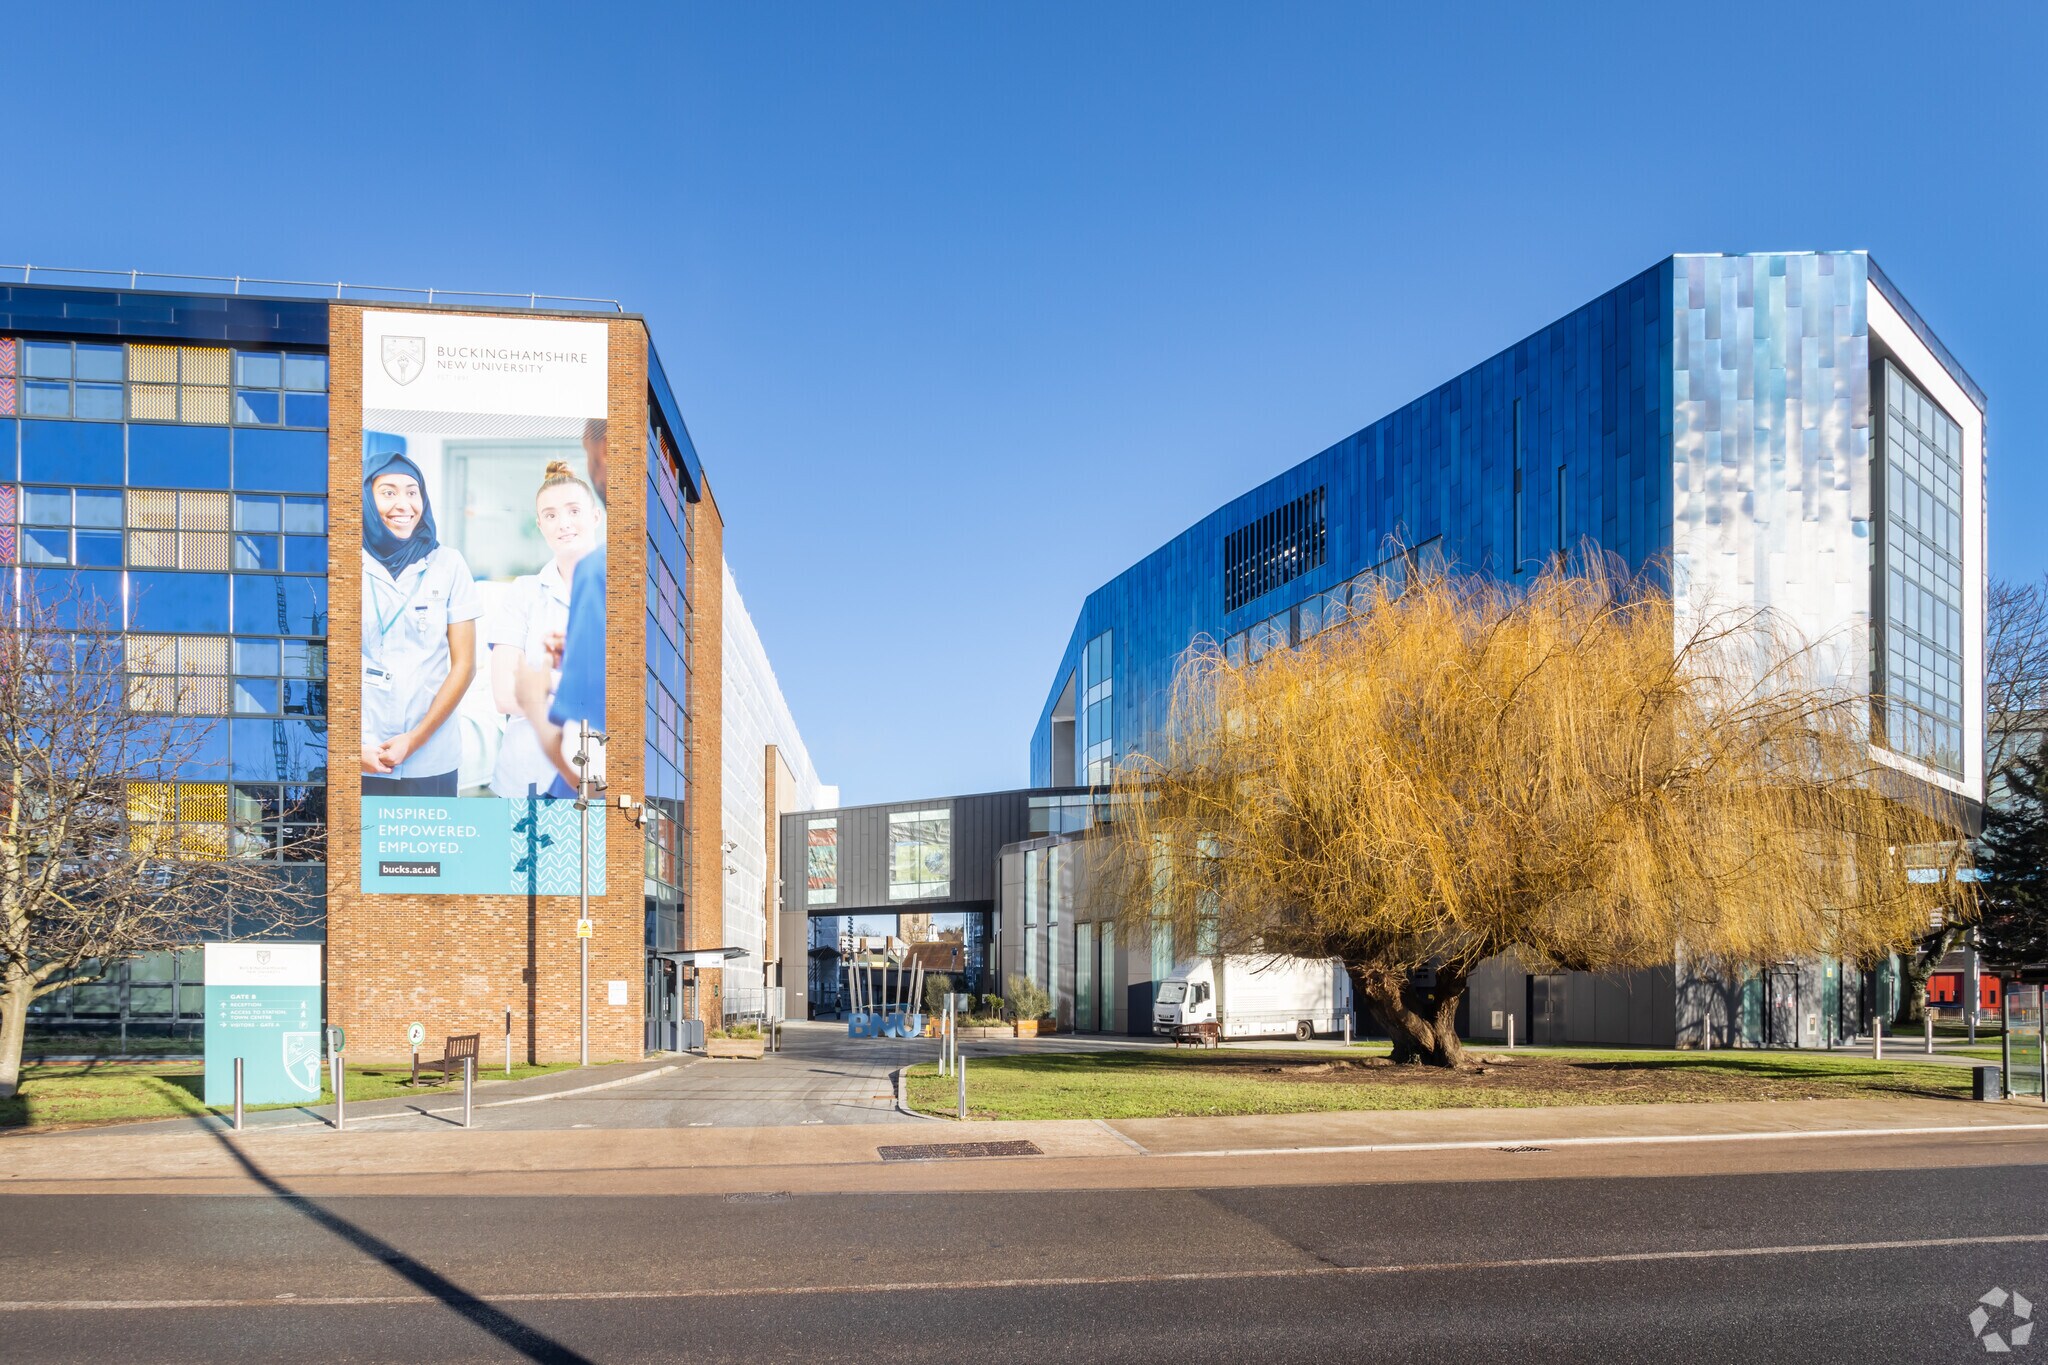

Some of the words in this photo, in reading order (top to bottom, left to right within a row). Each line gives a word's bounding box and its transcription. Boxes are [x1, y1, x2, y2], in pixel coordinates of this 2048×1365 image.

[437, 346, 588, 364] BUCKINGHAMSHIRE
[437, 360, 467, 370] NEW
[472, 361, 544, 374] UNIVERSITY
[378, 807, 452, 821] INSPIRED.
[378, 824, 481, 838] EMPOWERED.
[378, 841, 463, 854] EMPLOYED.
[382, 863, 437, 875] bucks.ac.uk
[848, 1013, 921, 1038] BNU
